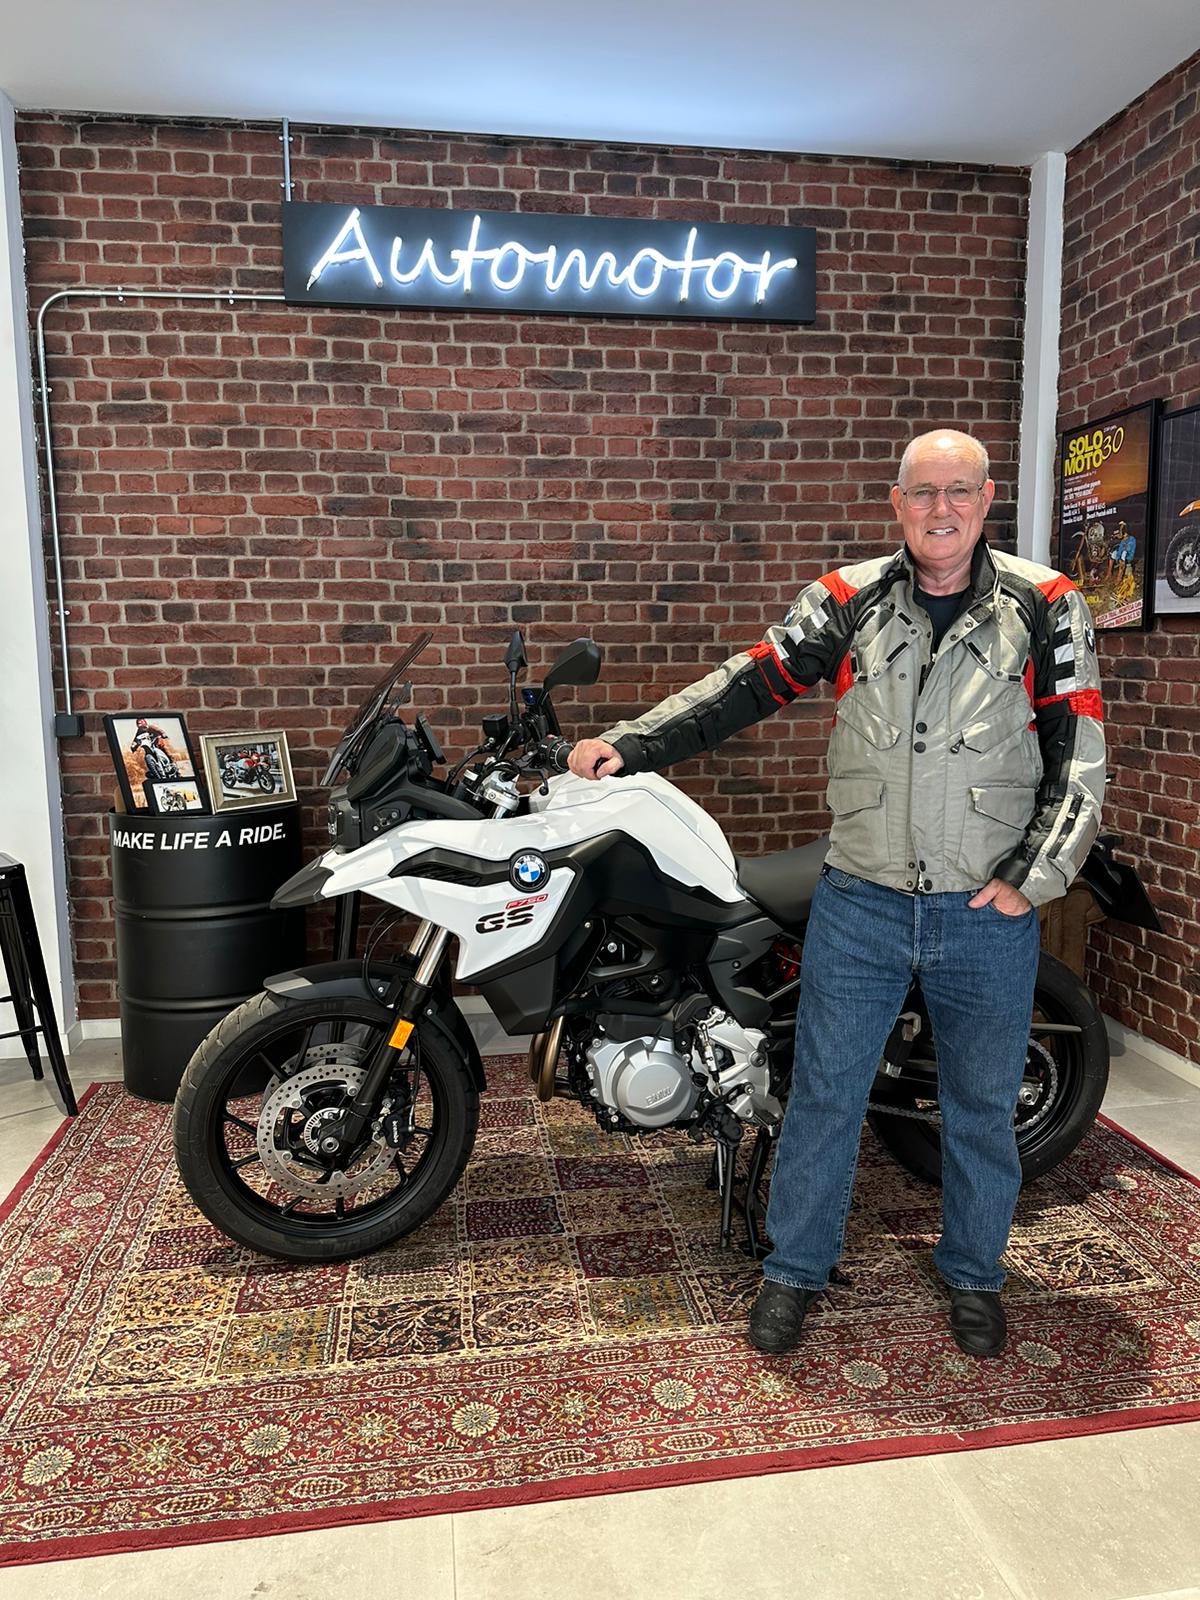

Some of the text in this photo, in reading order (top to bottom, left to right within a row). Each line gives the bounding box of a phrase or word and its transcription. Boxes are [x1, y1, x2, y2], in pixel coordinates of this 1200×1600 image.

[306, 208, 798, 304] Automotor
[1065, 427, 1124, 477] MOTO 30
[1069, 430, 1103, 458] SOLO
[113, 823, 286, 850] MAKE LIFE A RIDE.
[475, 905, 534, 934] GS
